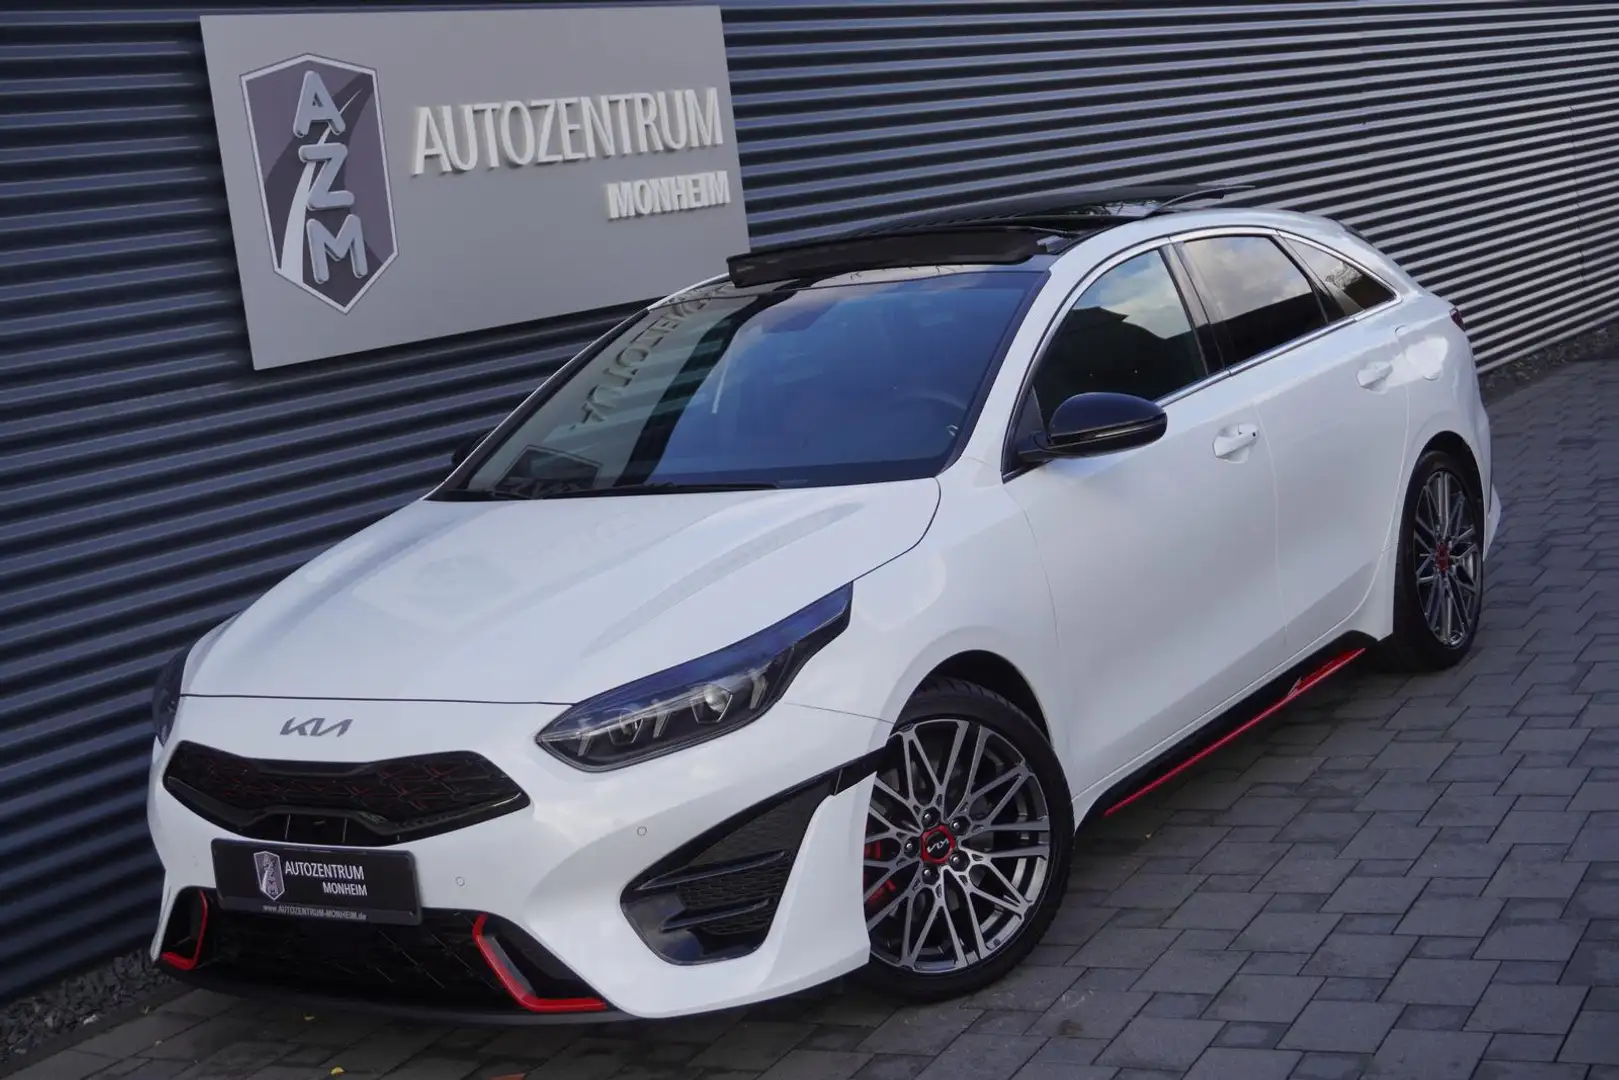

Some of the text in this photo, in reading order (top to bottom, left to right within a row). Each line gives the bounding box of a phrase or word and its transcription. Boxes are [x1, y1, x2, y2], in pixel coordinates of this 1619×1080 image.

[411, 87, 724, 176] AUTOZENTRUM
[607, 171, 730, 220] MONHEIM
[280, 717, 353, 737] KIA
[285, 861, 365, 880] AUTOZENTRUM
[322, 882, 368, 897] MONHEIM
[262, 904, 367, 921] www.AUTOZENTRUM-MONHEIM.de
